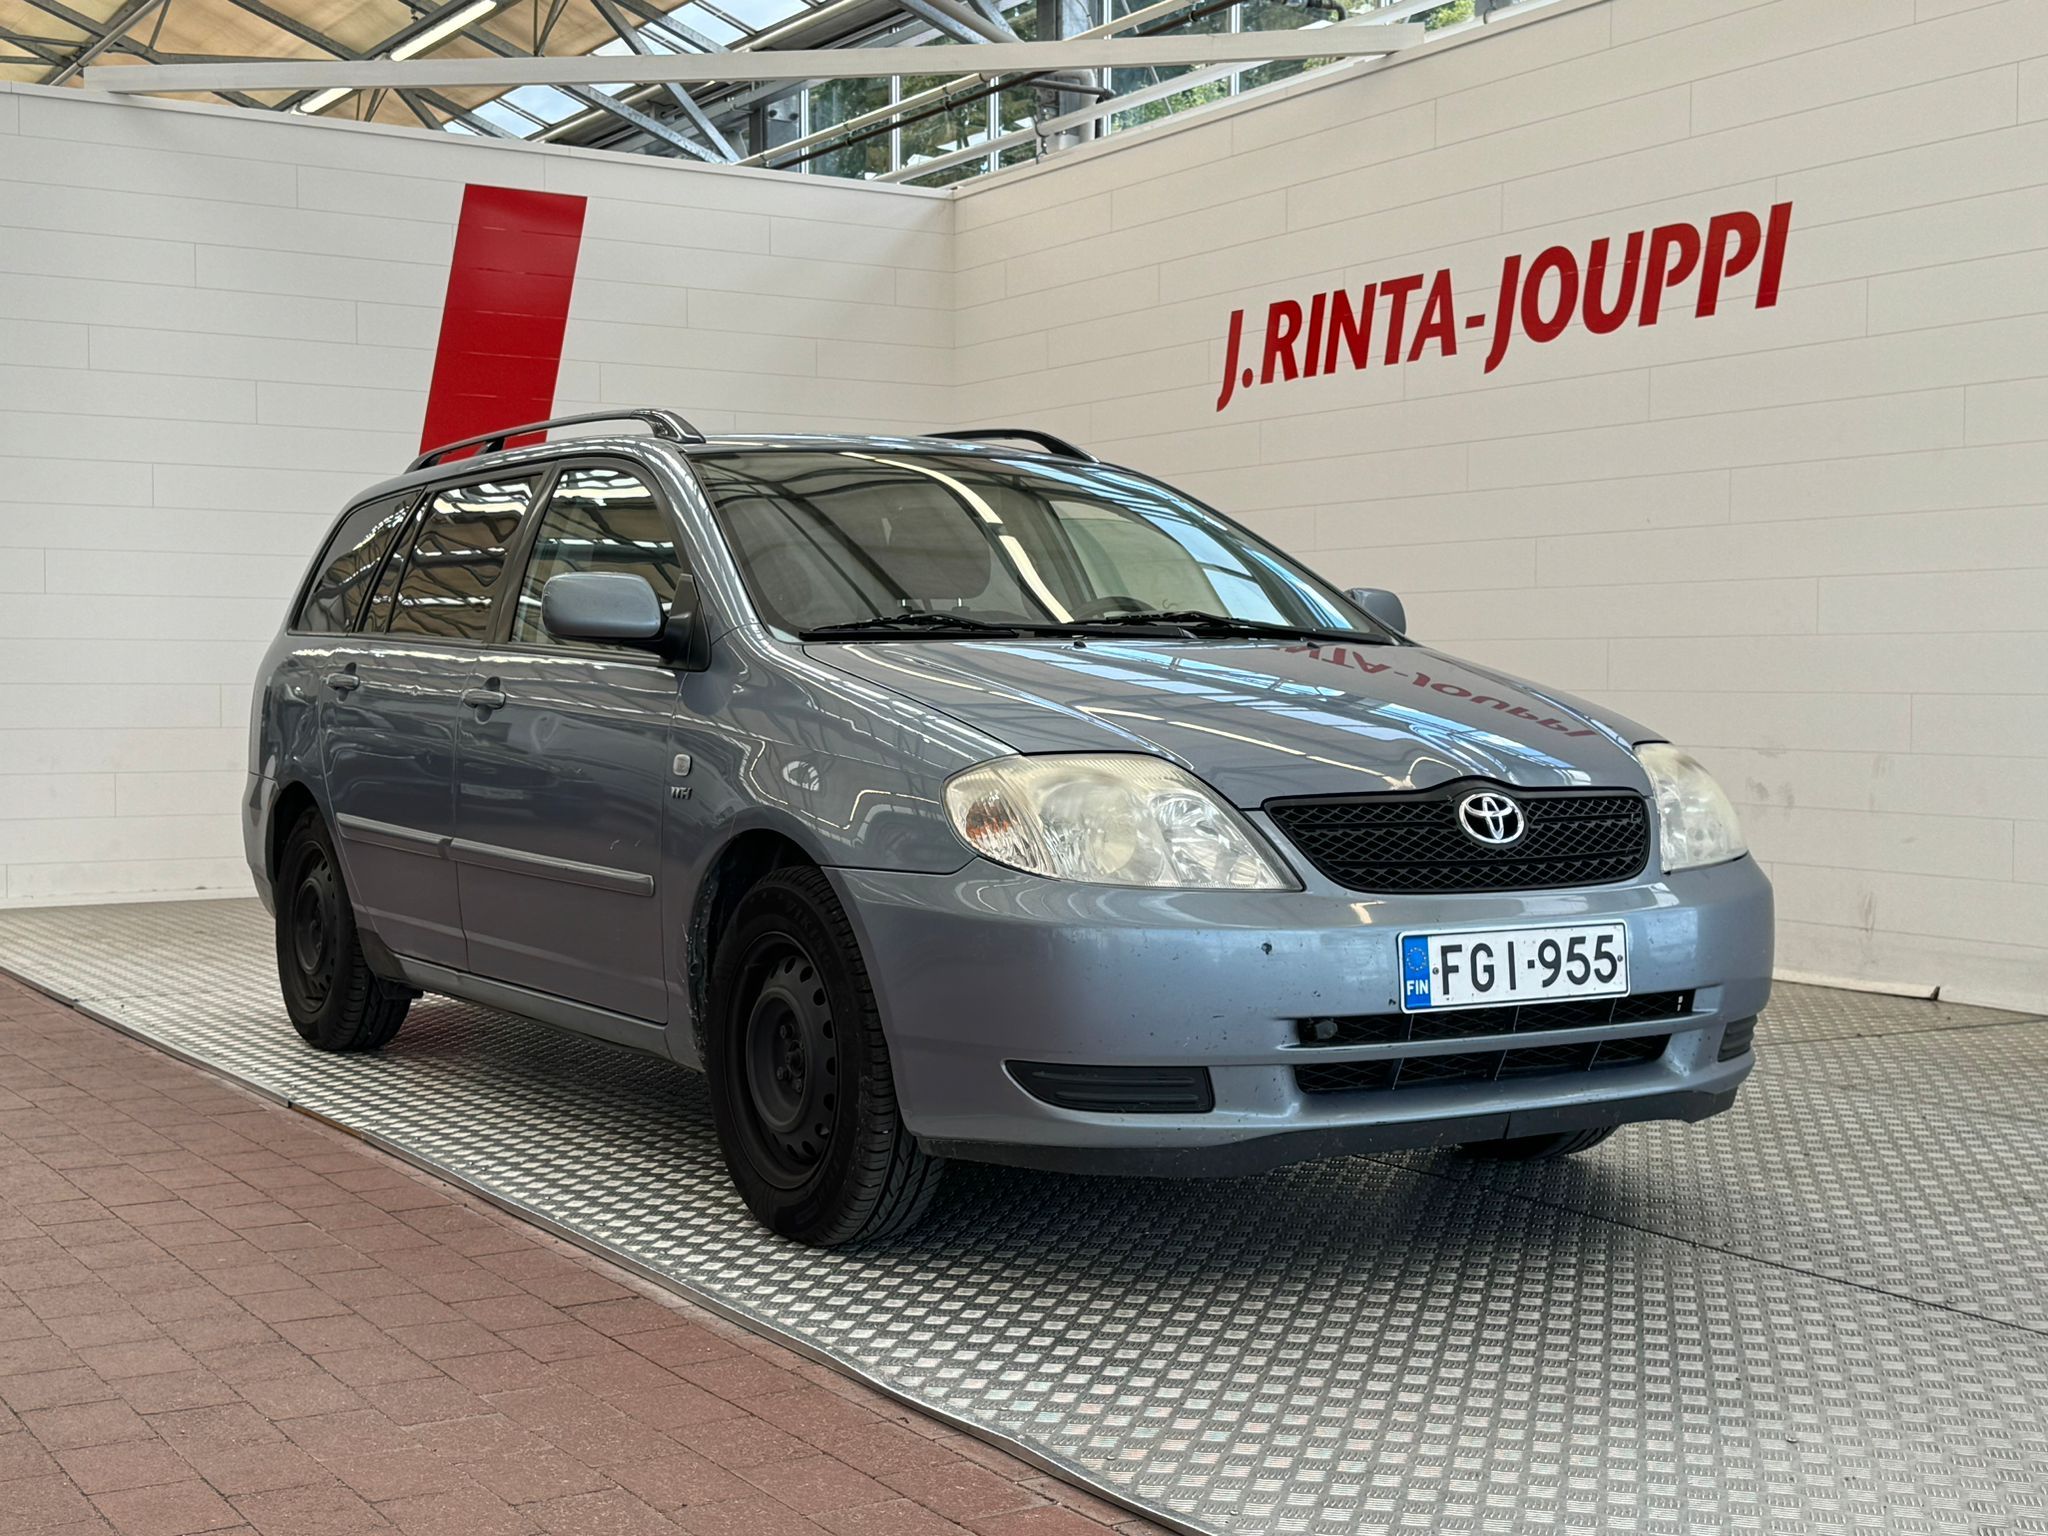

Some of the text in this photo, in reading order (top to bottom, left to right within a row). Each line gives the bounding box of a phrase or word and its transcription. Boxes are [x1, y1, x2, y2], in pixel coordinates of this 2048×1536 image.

[1216, 201, 1793, 412] J.RINTA-JOUPPI
[1406, 979, 1429, 996] FIN
[1440, 934, 1618, 996] FGI-955
